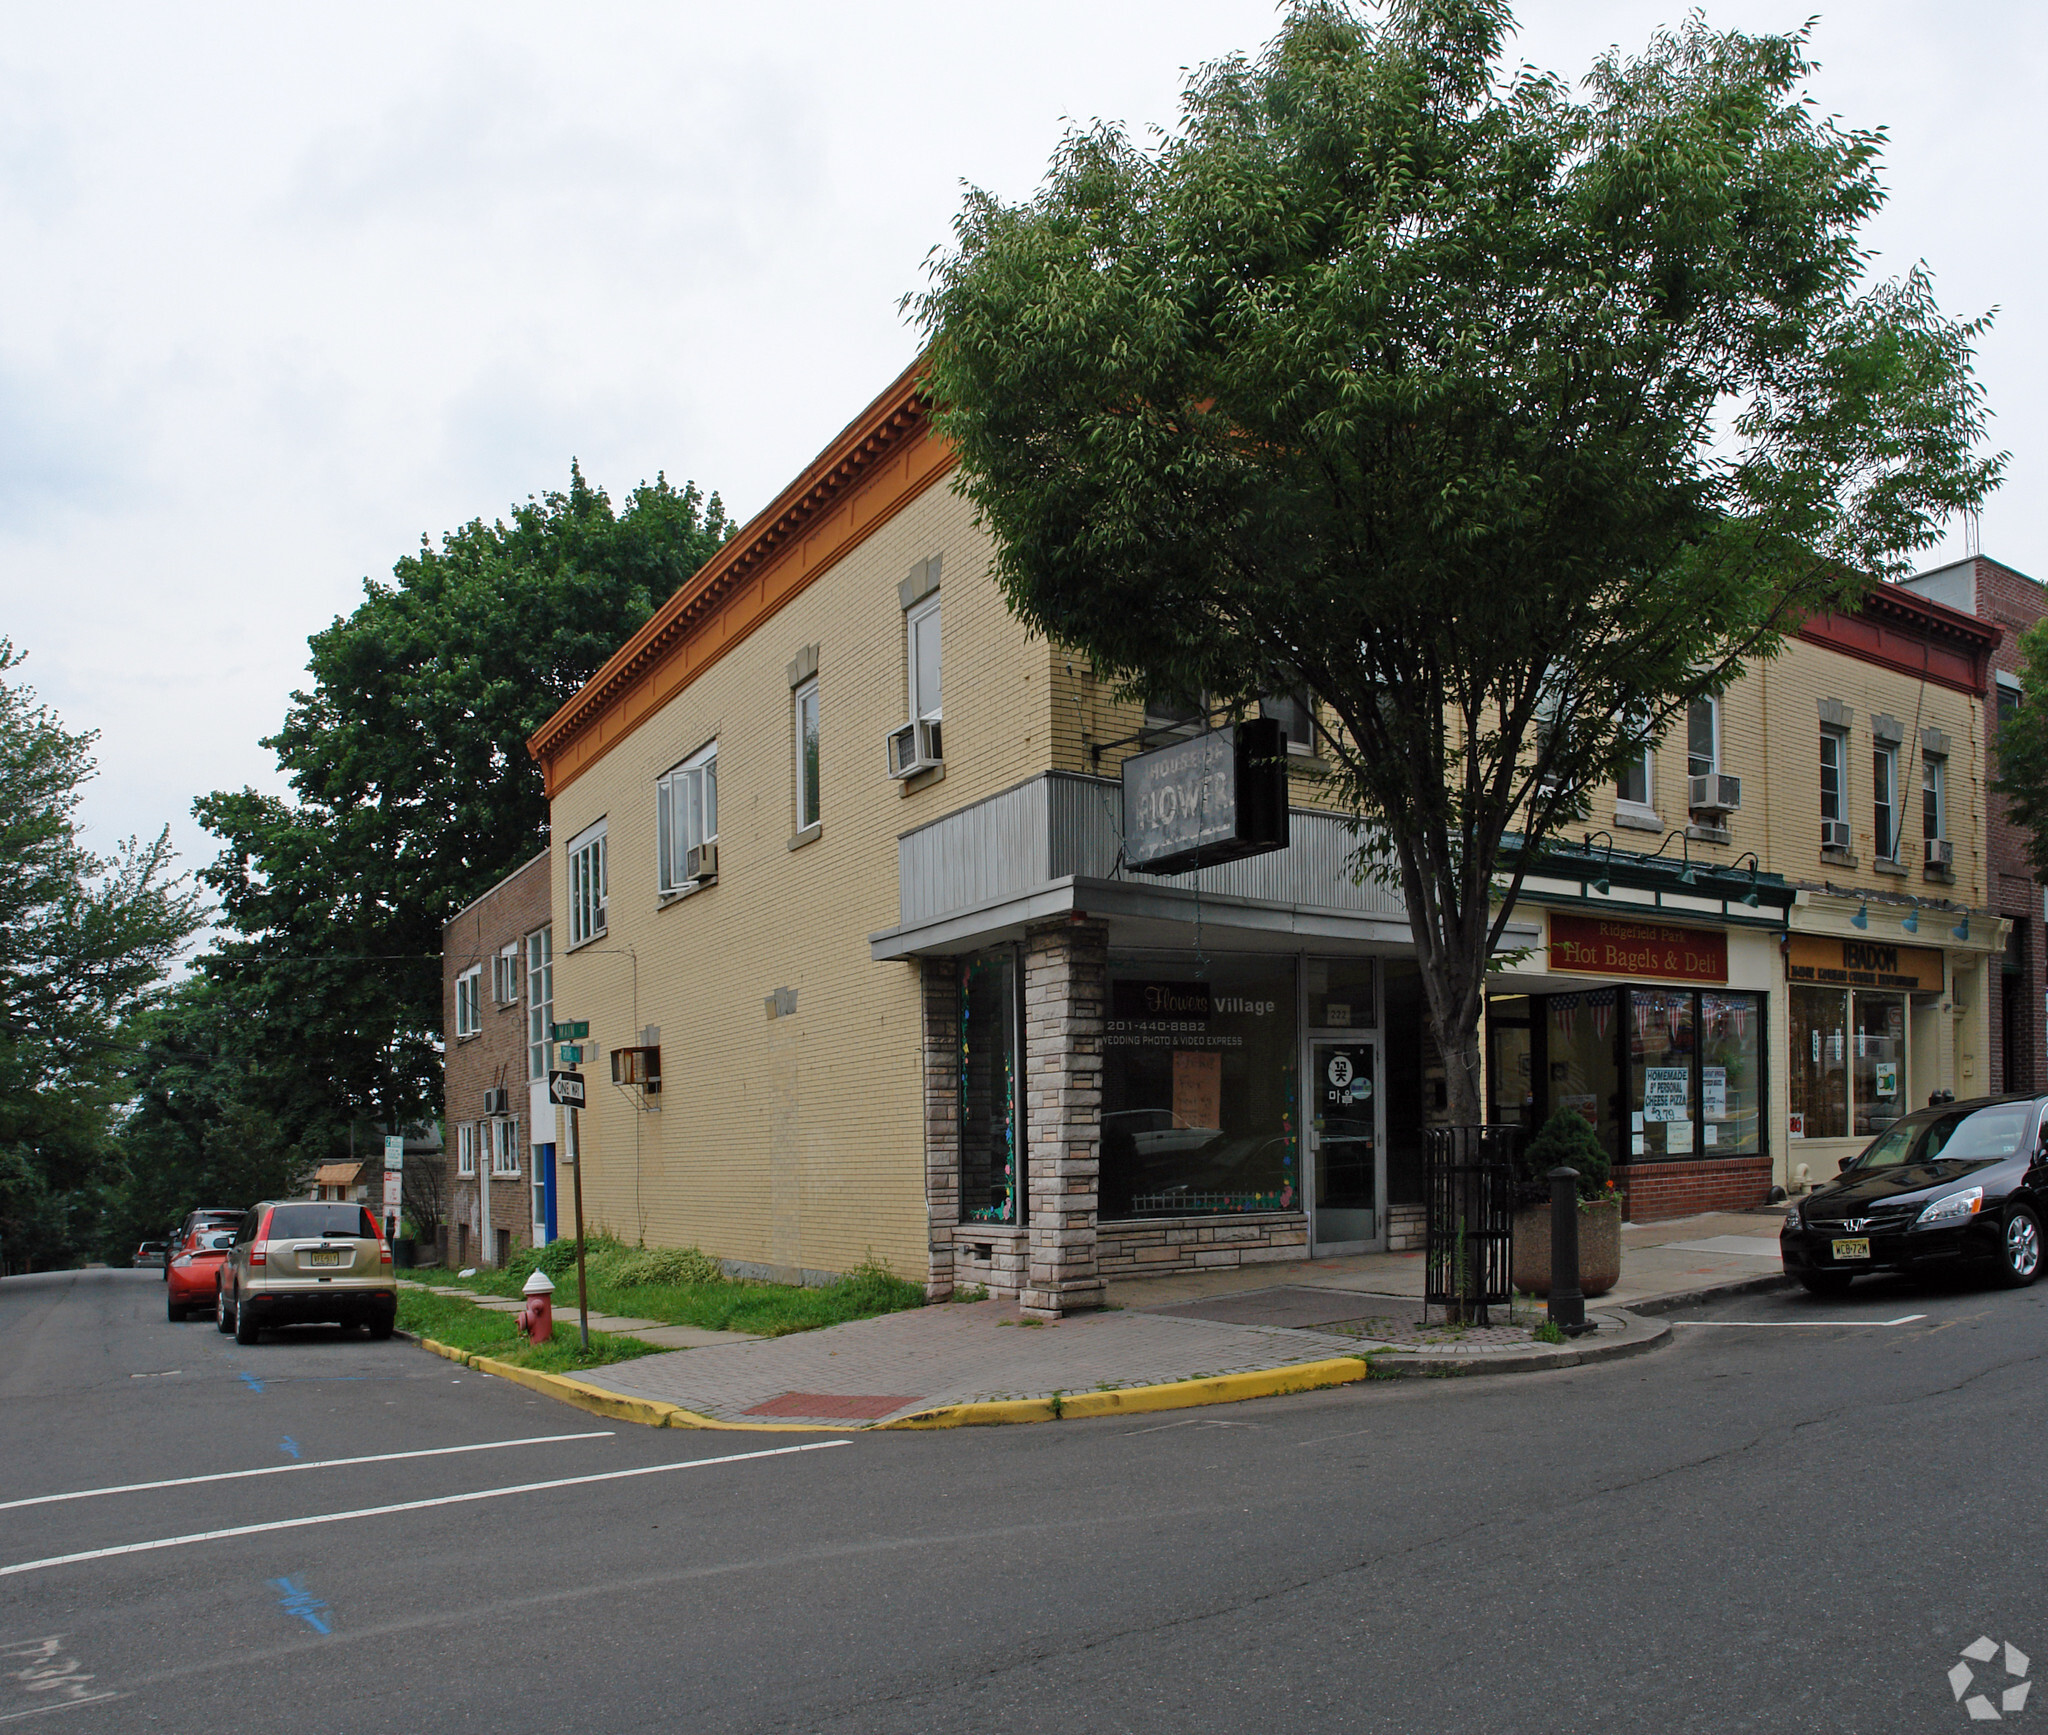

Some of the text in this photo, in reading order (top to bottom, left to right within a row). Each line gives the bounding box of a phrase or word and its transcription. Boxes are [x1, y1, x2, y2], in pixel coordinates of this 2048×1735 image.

[1599, 922, 1687, 943] Ridgefield Park
[1564, 941, 1717, 974] Hot Bagels & Deli
[1144, 985, 1275, 1016] Flowers Village
[1331, 1010, 1346, 1019] 222
[1107, 1021, 1206, 1031] 201-440-8882
[1142, 1036, 1171, 1046] PHOTO
[1172, 1037, 1178, 1045] &
[1180, 1036, 1205, 1046] VIDEO
[1207, 1036, 1243, 1046] EXPRESS
[1334, 1061, 1348, 1083] 꽃
[1647, 1071, 1687, 1081] HOMEMADE
[557, 1081, 581, 1097] ONE WAY
[1657, 1082, 1682, 1093] PERSONAL
[1645, 1094, 1687, 1107] CHEESE PIZZA
